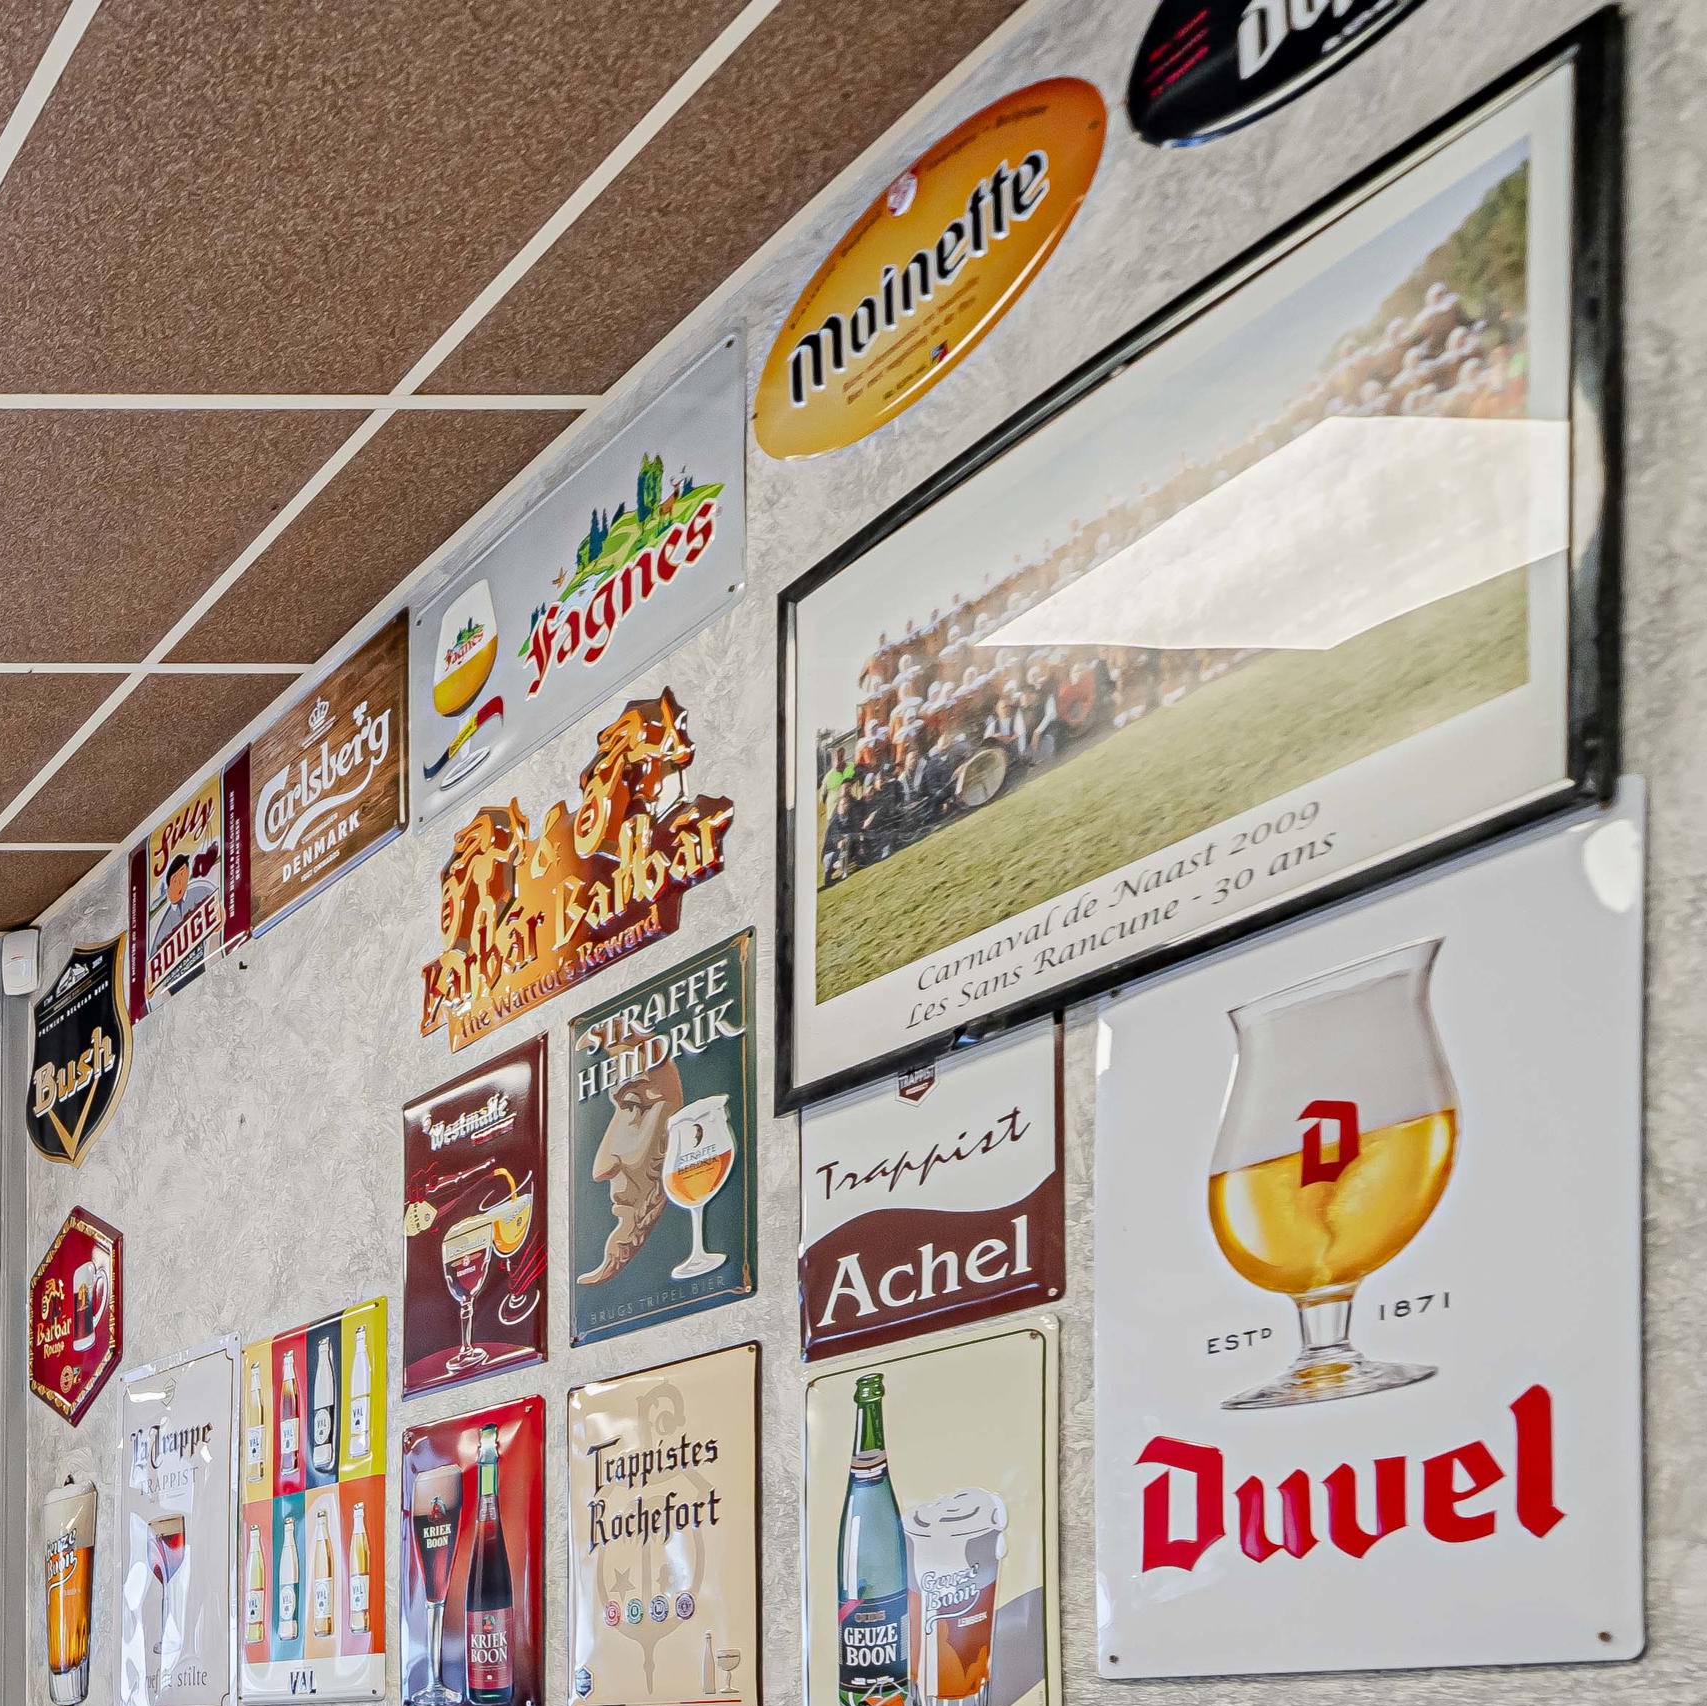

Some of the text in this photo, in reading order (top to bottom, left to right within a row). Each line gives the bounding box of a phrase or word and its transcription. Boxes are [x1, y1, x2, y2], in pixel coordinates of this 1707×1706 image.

[523, 499, 718, 702] Fagnes
[255, 708, 392, 853] Carlsberg
[152, 797, 215, 878] Silly
[282, 809, 361, 883] DENMARK
[917, 800, 1321, 992] Carnaval de Naast 2009
[150, 898, 219, 984] ROUGE
[906, 1001, 948, 1030] Les
[957, 965, 1024, 1008] Sans
[1033, 896, 1180, 976] Rancune
[1211, 867, 1255, 905] 30
[1268, 831, 1337, 877] ans
[66, 993, 93, 1018] BELGIAN
[94, 979, 109, 997] BEER
[455, 904, 663, 1039] The Warrior's Reward
[586, 958, 730, 1057] STRAFFE
[33, 1026, 116, 1118] Bush
[816, 1106, 1032, 1200] Trappist
[1294, 1098, 1361, 1189] D
[590, 1274, 726, 1325] BRUGS TRIPEL BIER
[816, 1214, 1033, 1328] Achel
[1377, 1291, 1452, 1322] 1871
[43, 1340, 65, 1359] Rouge
[149, 1420, 215, 1470] Trappe
[587, 1432, 719, 1495] Trappistes
[139, 1466, 199, 1496] TRAPPIST
[1135, 1383, 1566, 1573] Duvel
[423, 1523, 452, 1539] KRIEK
[426, 1536, 449, 1549] BOON
[587, 1488, 722, 1555] Rochefort
[921, 1562, 980, 1592] Geuze
[470, 1630, 508, 1649] KRIEK
[470, 1648, 508, 1664] BOON
[843, 1623, 898, 1647] GEUZE
[845, 1644, 897, 1667] BOON
[176, 1668, 208, 1689] stilte
[289, 1670, 317, 1695] VAL
